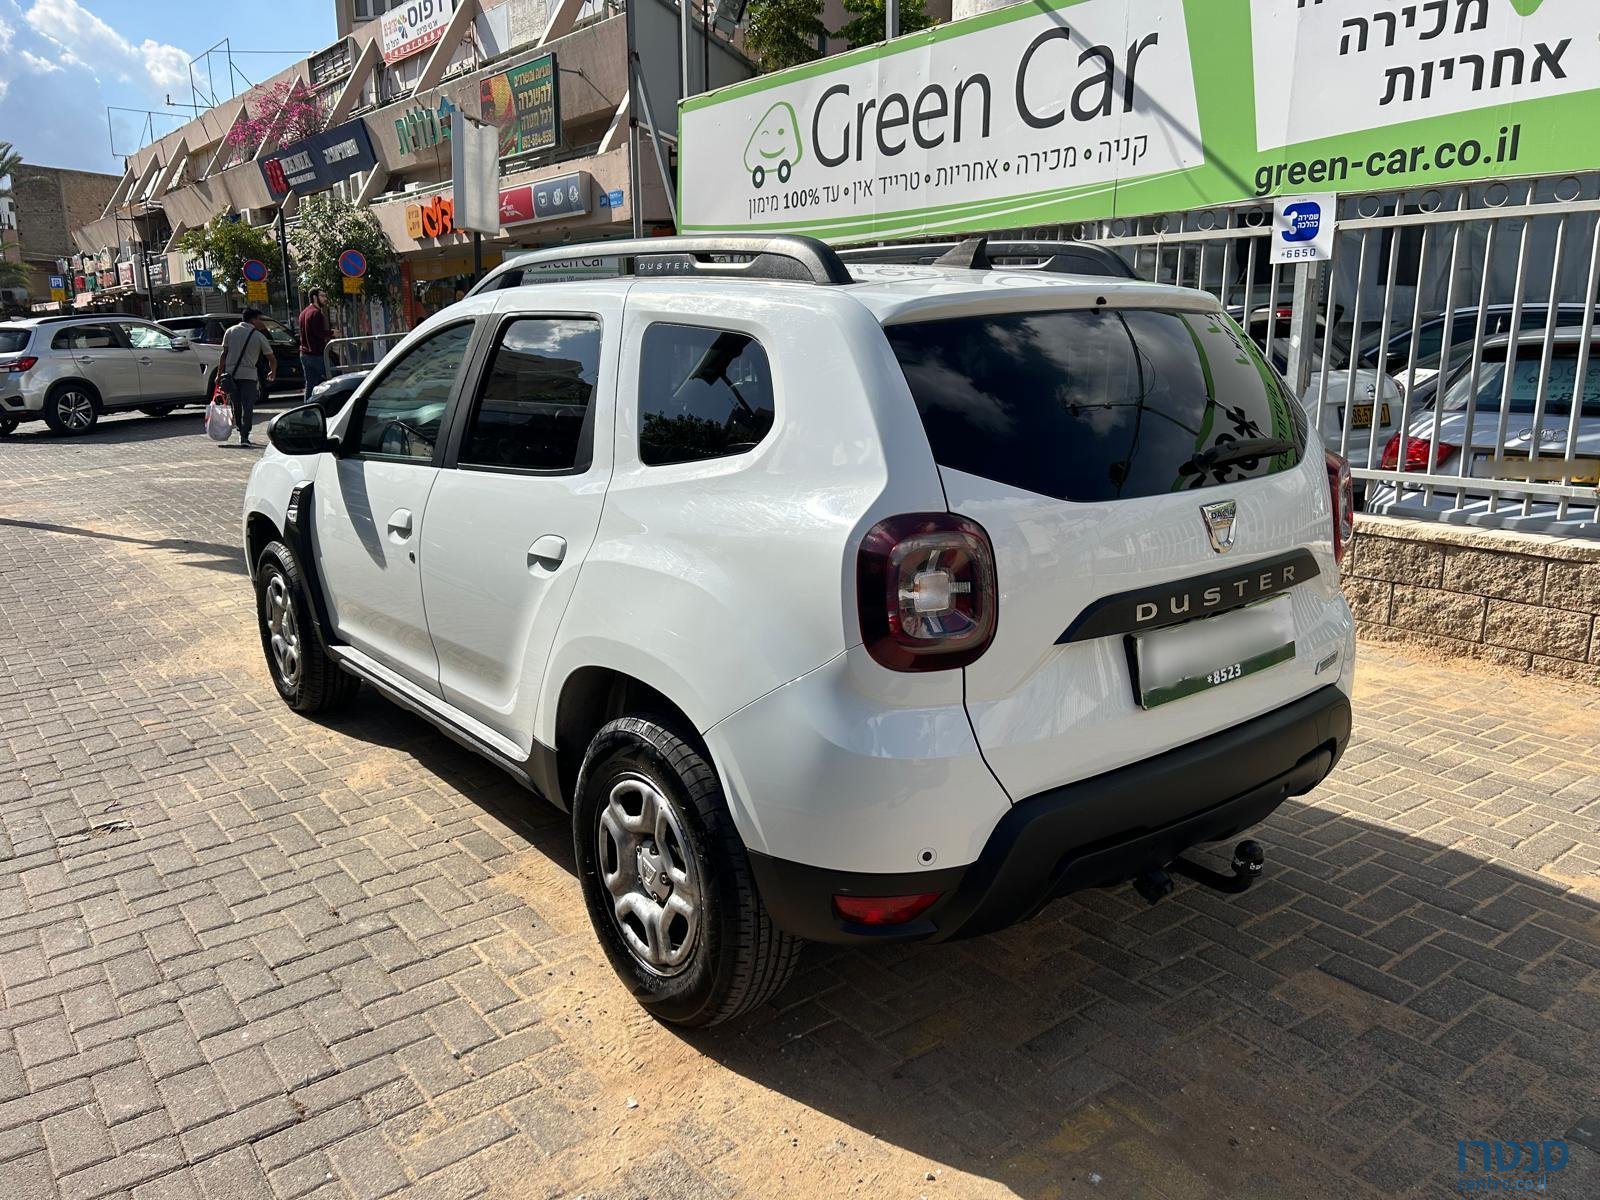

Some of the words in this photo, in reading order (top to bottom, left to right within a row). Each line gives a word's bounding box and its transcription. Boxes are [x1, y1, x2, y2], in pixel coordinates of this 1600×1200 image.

[1338, 0, 1490, 56] מכירה
[1378, 37, 1573, 106] אחריות
[811, 72, 992, 168] Green
[1015, 26, 1160, 130] Car
[1016, 146, 1078, 175] מכירה
[1098, 134, 1149, 166] קניה
[1254, 124, 1522, 197] green-car.co.il
[878, 171, 920, 195] טרייד
[935, 158, 999, 187] אחריות
[783, 188, 820, 210] 100%
[822, 185, 841, 203] עד
[852, 178, 874, 205] אין
[748, 194, 779, 220] מימון
[1297, 213, 1320, 221] שמירה
[1297, 221, 1319, 229] כהלכה
[639, 262, 690, 270] DUSTER
[1211, 509, 1235, 519] DACIA
[1136, 565, 1296, 622] DUSTER
